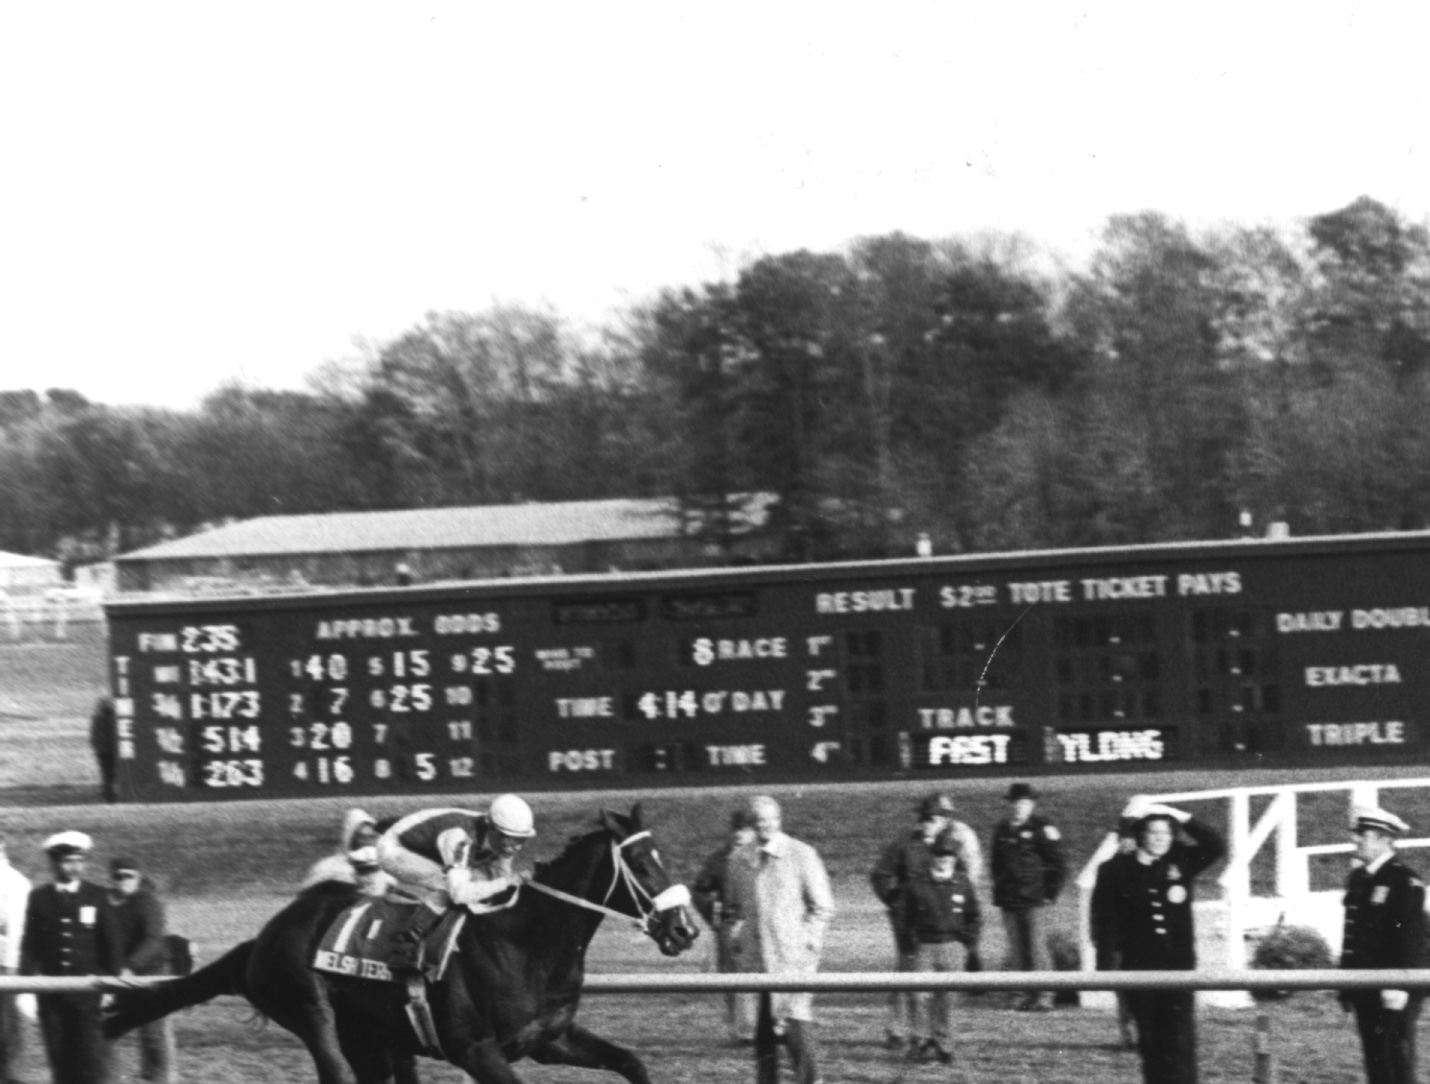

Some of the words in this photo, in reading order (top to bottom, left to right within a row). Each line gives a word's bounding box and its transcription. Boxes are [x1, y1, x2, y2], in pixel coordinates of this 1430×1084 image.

[818, 590, 915, 614] RESULT
[1010, 581, 1071, 604] TOTE
[1082, 576, 1168, 600] TICKET
[1179, 573, 1242, 596] PAYS
[436, 614, 500, 635] ODDS
[1278, 612, 1343, 633] DAILY
[719, 638, 787, 659] RACE
[307, 655, 347, 681] 40
[395, 651, 430, 677] 15
[473, 647, 515, 675] 25
[1307, 665, 1401, 687] EXACTA
[332, 689, 349, 715] 7
[392, 685, 432, 713] 25
[557, 698, 613, 718] TIME
[920, 707, 1014, 728] TRACK
[312, 723, 352, 750] 20
[1308, 722, 1405, 746] TRIPLE
[550, 751, 615, 771] POST
[709, 745, 766, 765] TIME
[930, 736, 1011, 765] FAST
[320, 757, 354, 784] 16
[417, 754, 436, 781] 5
